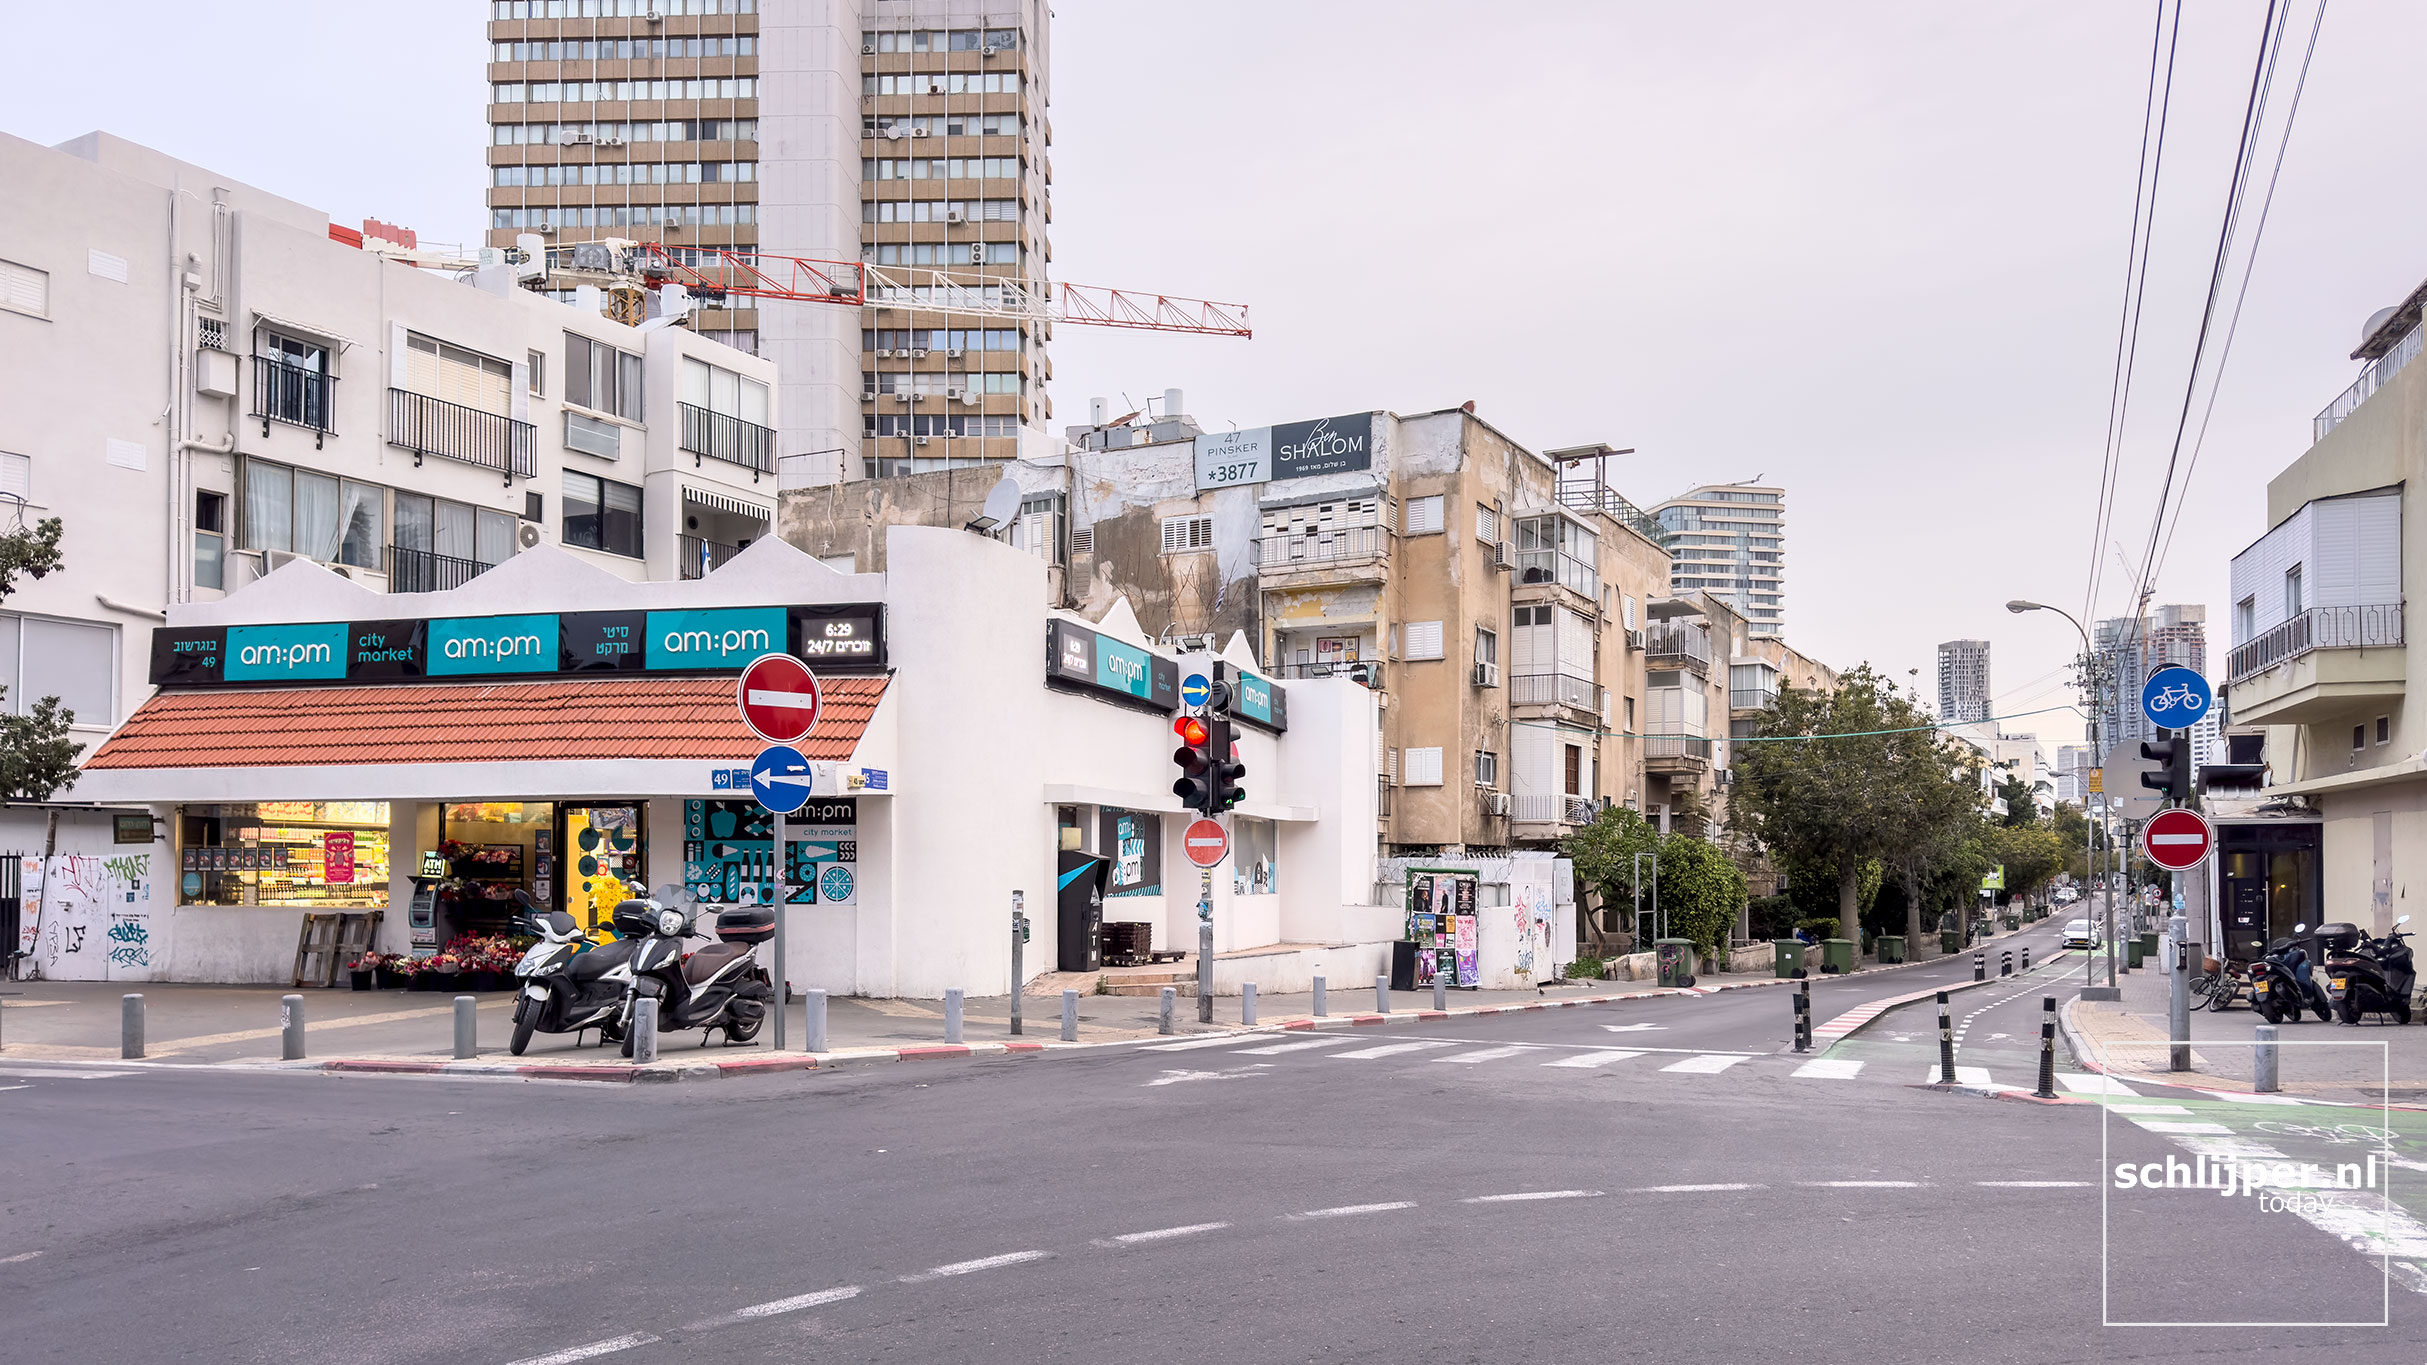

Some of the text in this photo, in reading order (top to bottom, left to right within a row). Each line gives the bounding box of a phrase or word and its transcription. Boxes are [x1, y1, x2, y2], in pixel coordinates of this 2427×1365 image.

[1224, 432, 1241, 443] 47
[1306, 418, 1338, 450] Ben
[1208, 442, 1258, 457] PINSKER
[1280, 435, 1363, 461] SHALOM
[602, 626, 629, 638] סיטי
[825, 623, 852, 637] 6:29
[173, 640, 217, 652] בוגרשוב
[359, 633, 386, 649] city
[444, 635, 541, 662] am:pm
[664, 629, 769, 657] am:pm
[807, 639, 834, 655] 24/7
[240, 643, 331, 670] am:pm
[358, 646, 414, 663] market
[596, 642, 629, 656] מרקט
[201, 656, 216, 668] 49
[1108, 654, 1143, 682] am:pm
[714, 773, 729, 786] 49
[803, 828, 852, 837] city market
[423, 858, 442, 870] ATM
